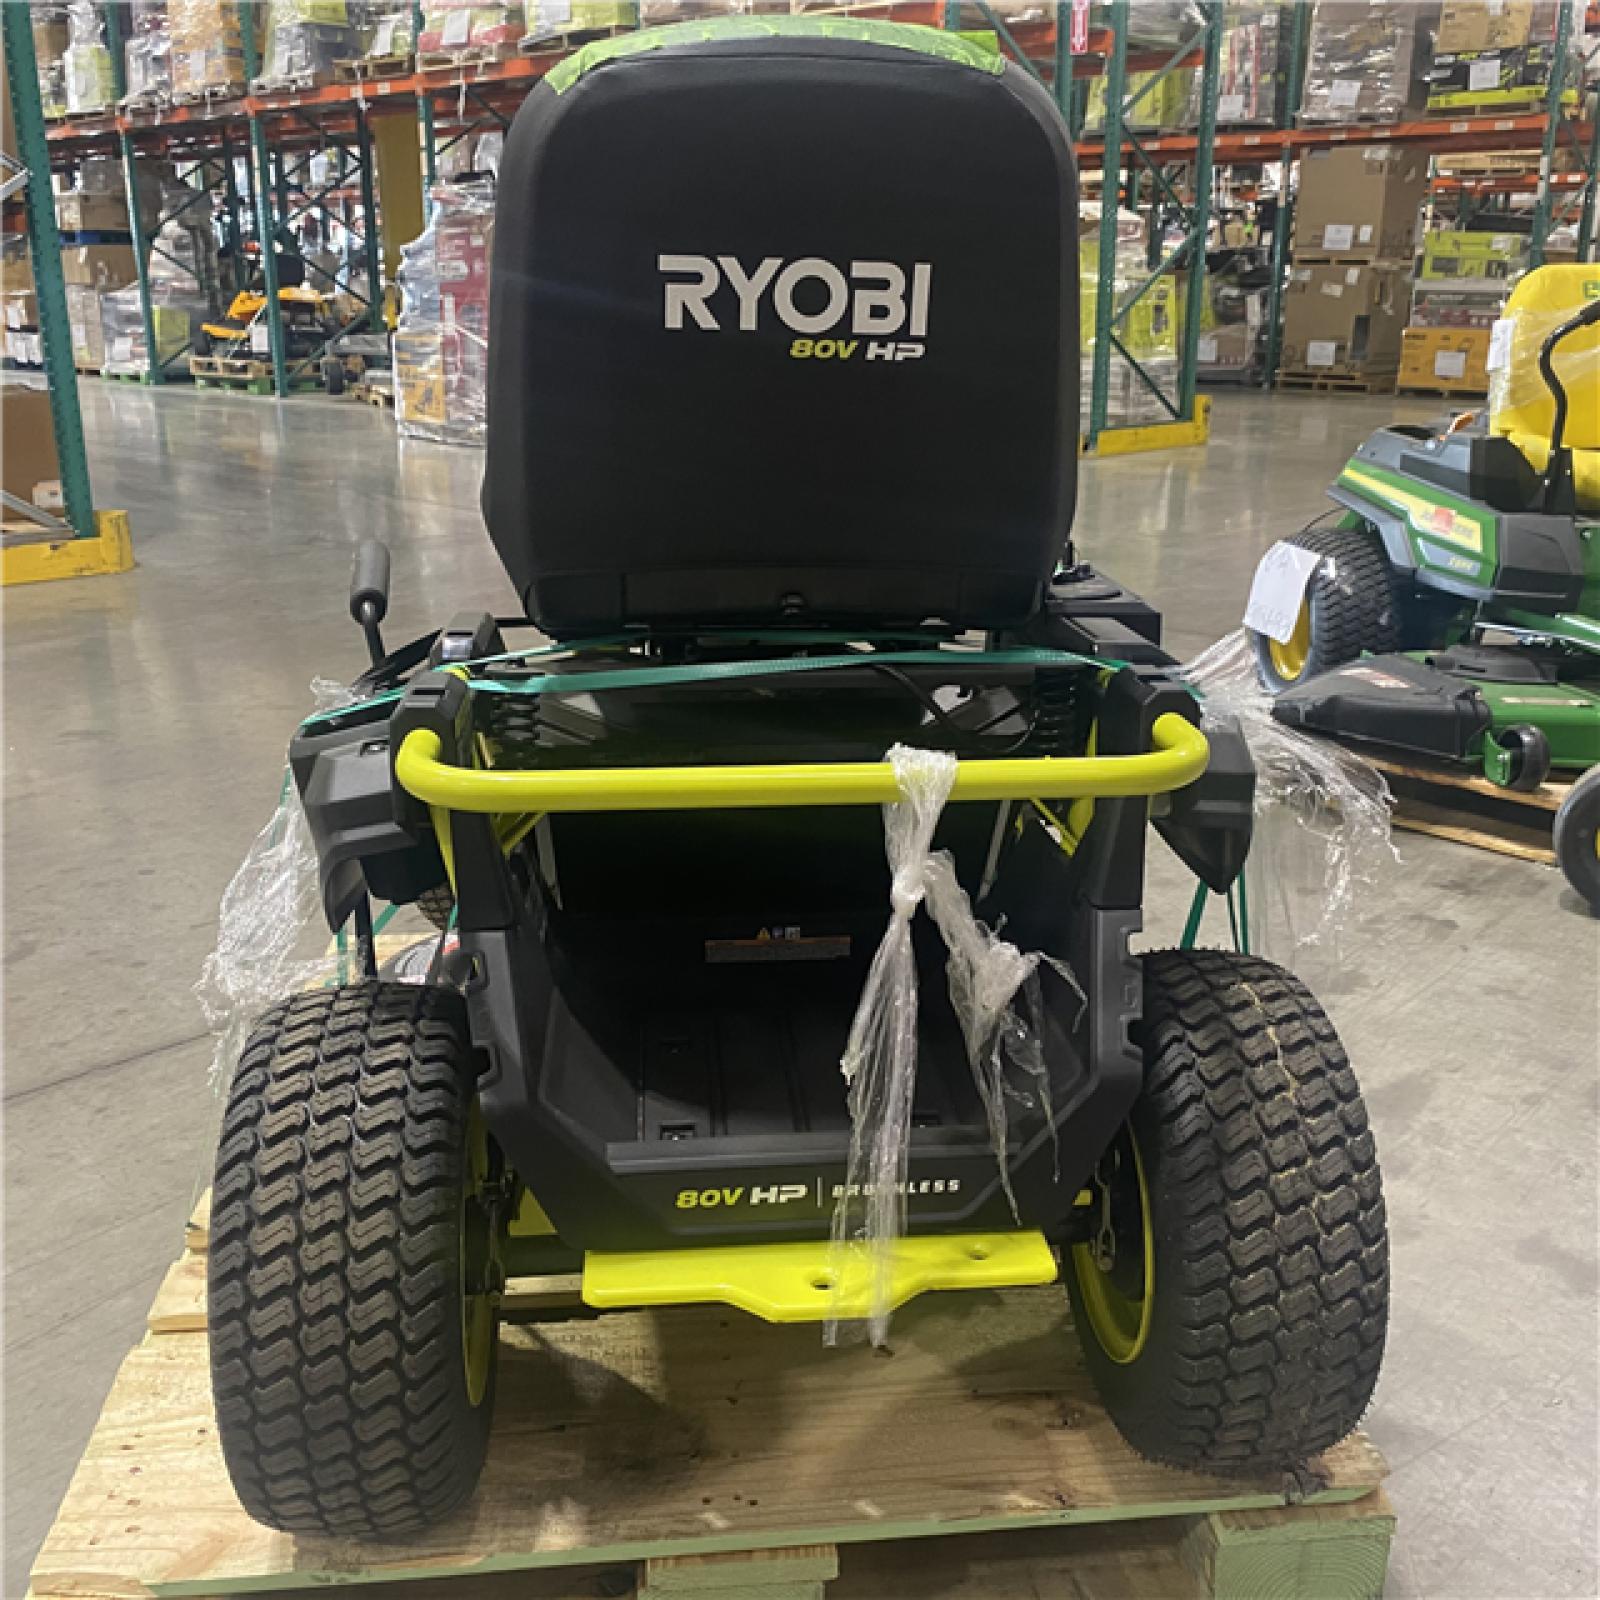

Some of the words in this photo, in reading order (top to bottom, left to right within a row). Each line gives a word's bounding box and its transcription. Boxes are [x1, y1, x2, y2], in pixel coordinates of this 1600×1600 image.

[658, 254, 931, 336] RYOBI
[790, 339, 859, 359] 80V
[865, 341, 926, 361] HP
[675, 1186, 744, 1208] 80V
[749, 1184, 808, 1205] HP
[832, 1179, 961, 1197] BRULESS
